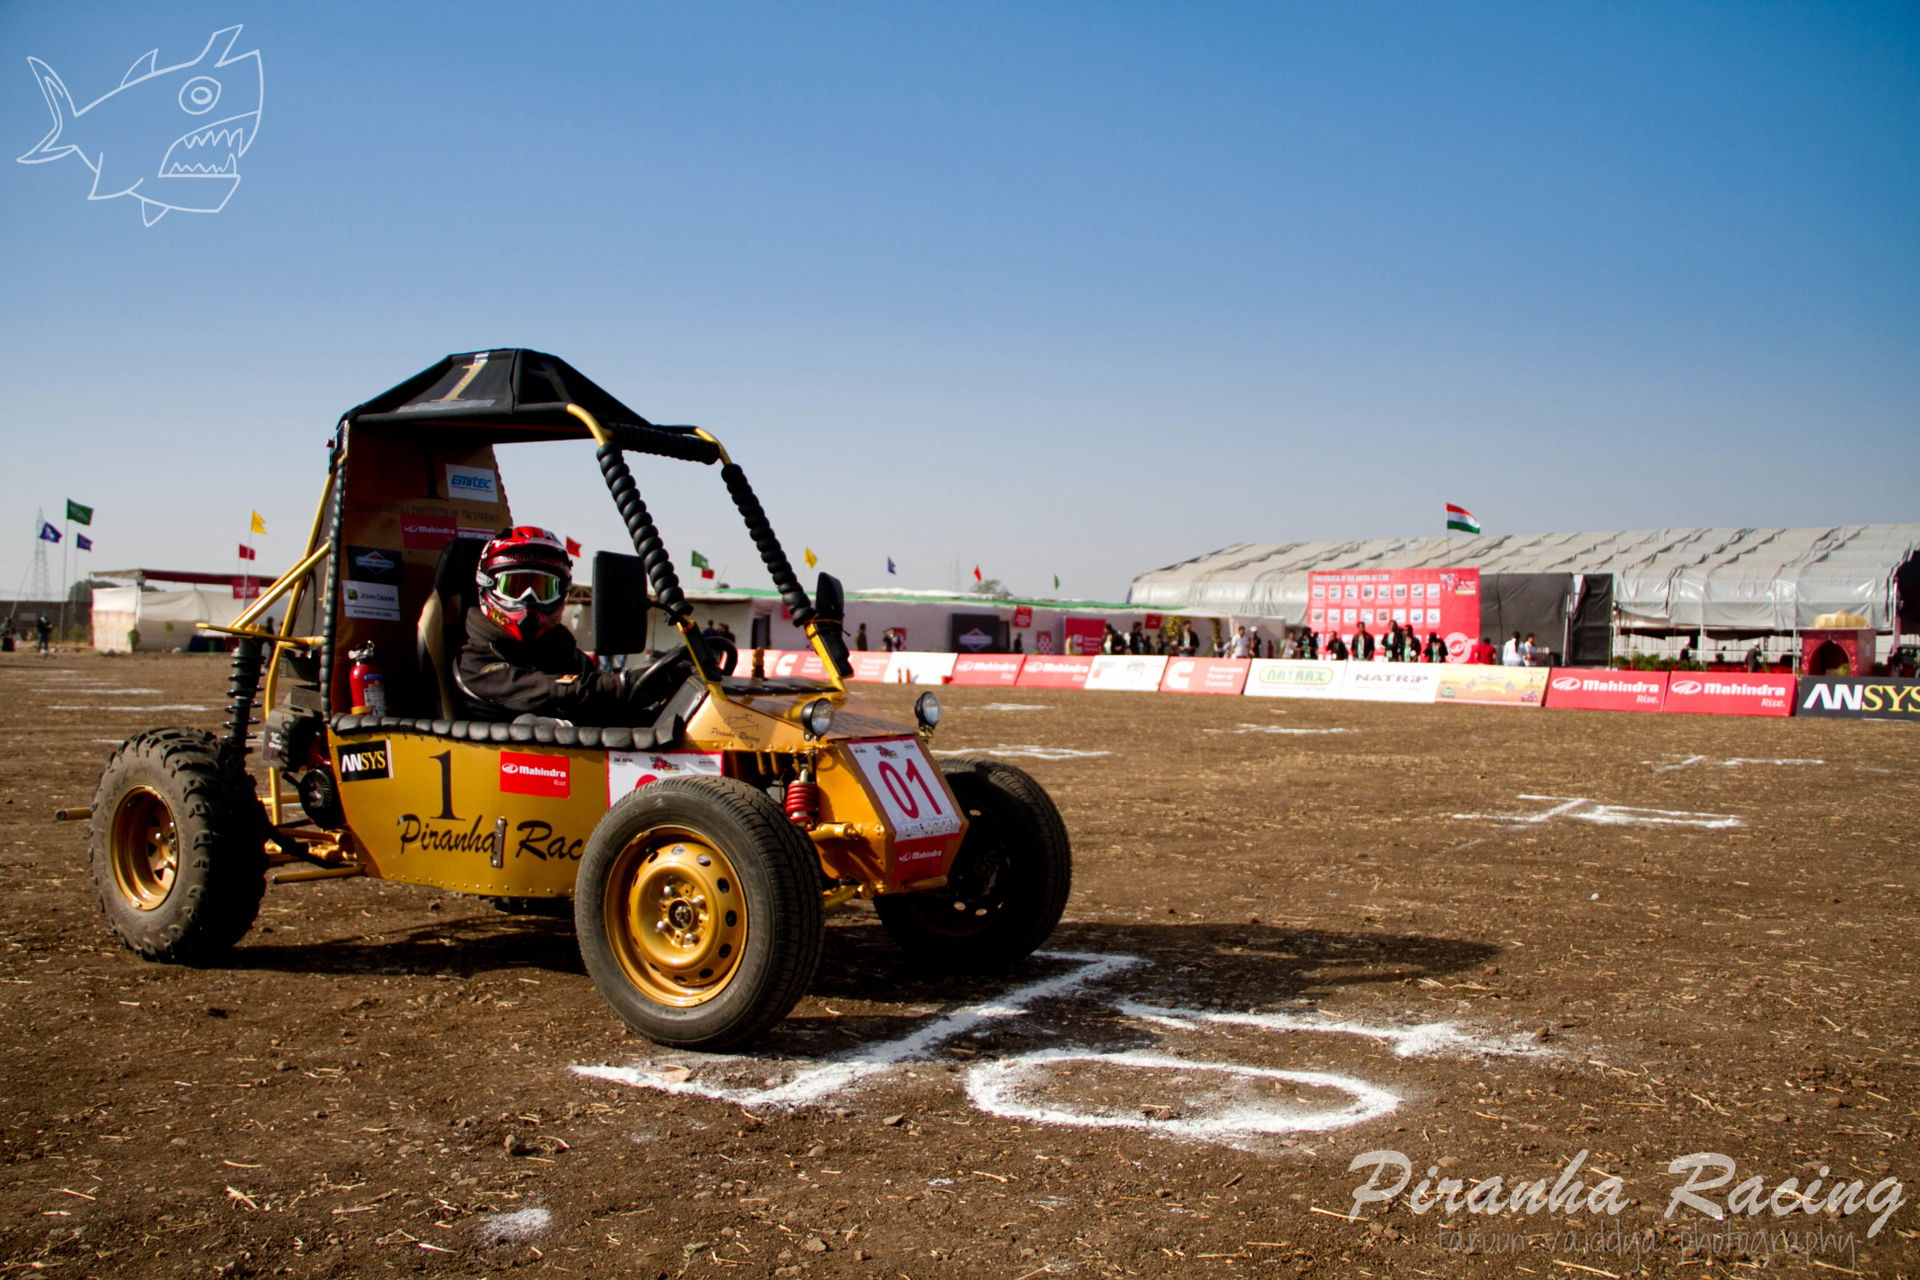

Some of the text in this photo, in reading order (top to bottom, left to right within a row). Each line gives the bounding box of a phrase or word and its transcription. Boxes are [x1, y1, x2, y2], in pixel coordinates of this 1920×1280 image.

[430, 352, 488, 402] 1
[418, 526, 456, 535] Mahindra
[1582, 680, 1660, 693] Mahindra
[1703, 683, 1786, 697] Mahindra
[1803, 682, 1920, 713] ANSYS
[341, 750, 387, 773] ANSYS
[519, 765, 567, 779] Mahindra
[429, 750, 466, 821] 1
[878, 758, 943, 819] 01
